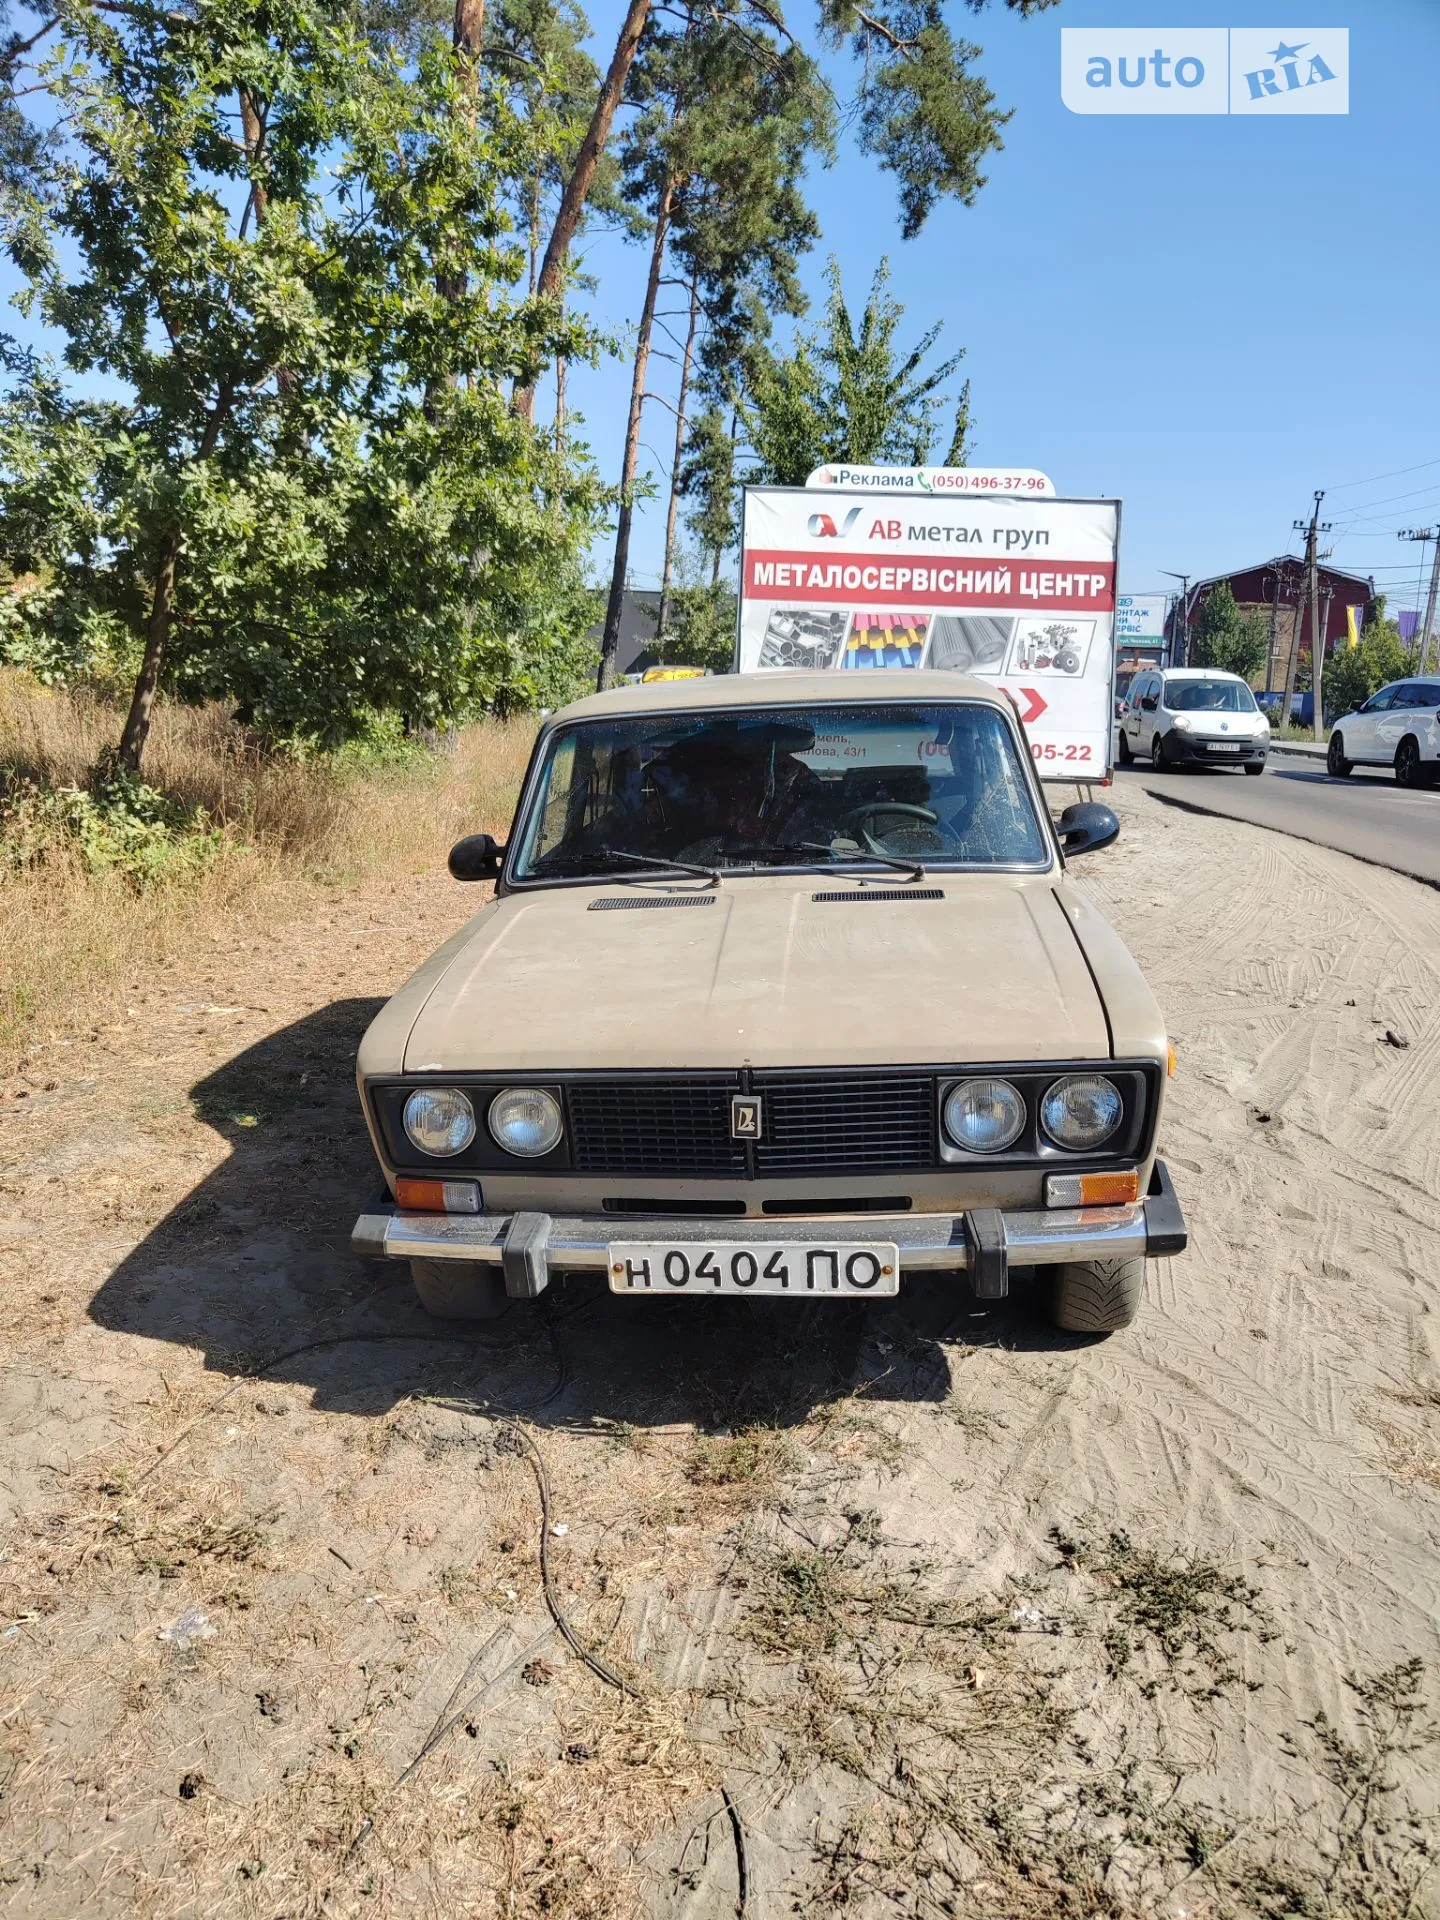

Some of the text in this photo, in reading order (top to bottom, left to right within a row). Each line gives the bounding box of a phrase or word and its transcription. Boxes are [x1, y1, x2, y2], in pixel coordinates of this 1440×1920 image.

[839, 470, 1045, 491] Реклама (050) 496-37-96
[868, 519, 1050, 550] АВ метал груп
[753, 562, 1106, 599] МЕТАЛОСЕРВІСНИЙ ЦЕНТР
[1116, 609, 1150, 617] ОНТАЖ
[1116, 625, 1142, 633] ЕРВІС
[816, 735, 851, 745] мель,
[916, 740, 1092, 761] (06 05-22
[797, 747, 867, 758] алова, 43/1
[663, 1250, 790, 1287] 0404
[806, 1250, 882, 1289] ПО
